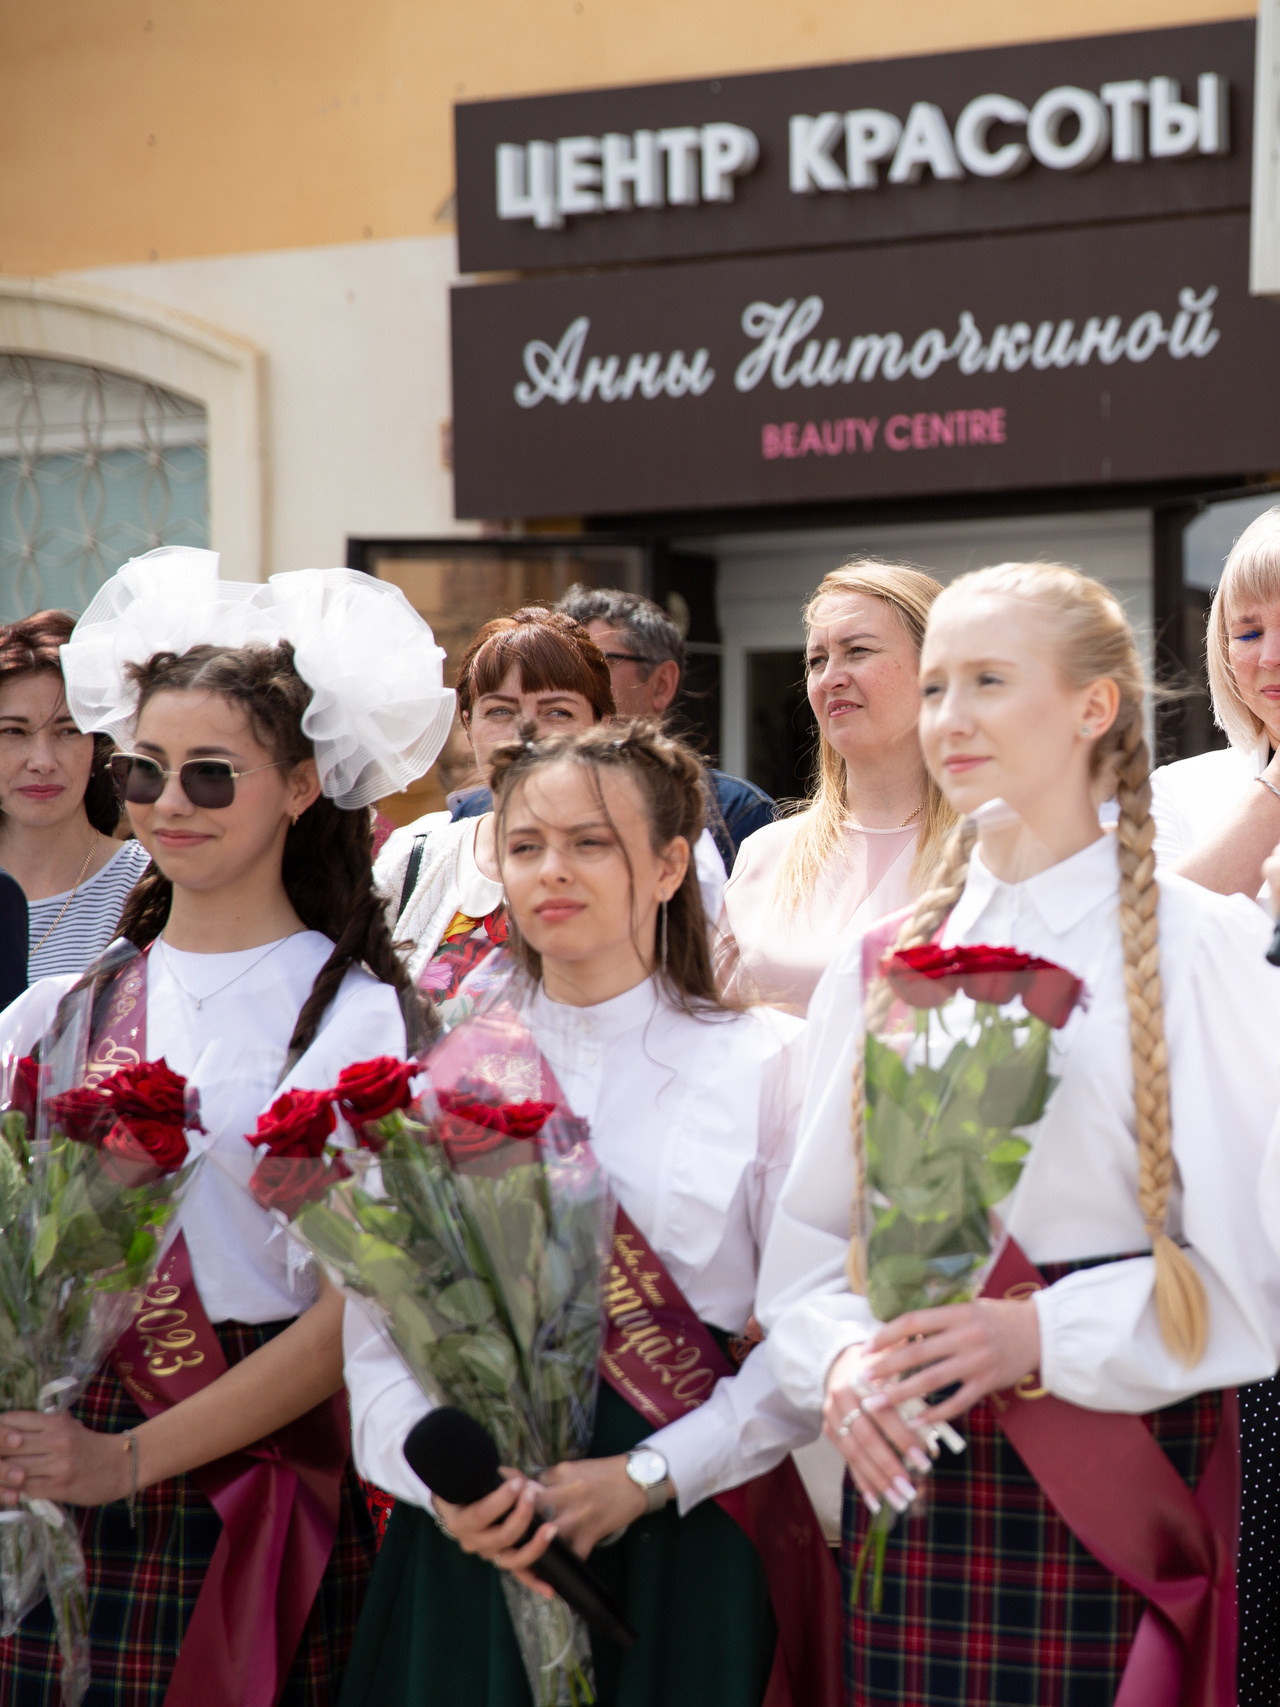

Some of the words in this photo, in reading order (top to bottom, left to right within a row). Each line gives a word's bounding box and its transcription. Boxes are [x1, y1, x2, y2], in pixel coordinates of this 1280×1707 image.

[496, 122, 759, 229] ЦЕНТР
[789, 72, 1229, 194] КРАСОТЫ
[514, 316, 715, 408] Анны
[734, 286, 1221, 392] Ниточкиной
[762, 416, 878, 460] BEAUTY
[885, 407, 1008, 452] CENTRE
[131, 1284, 205, 1377] 2023
